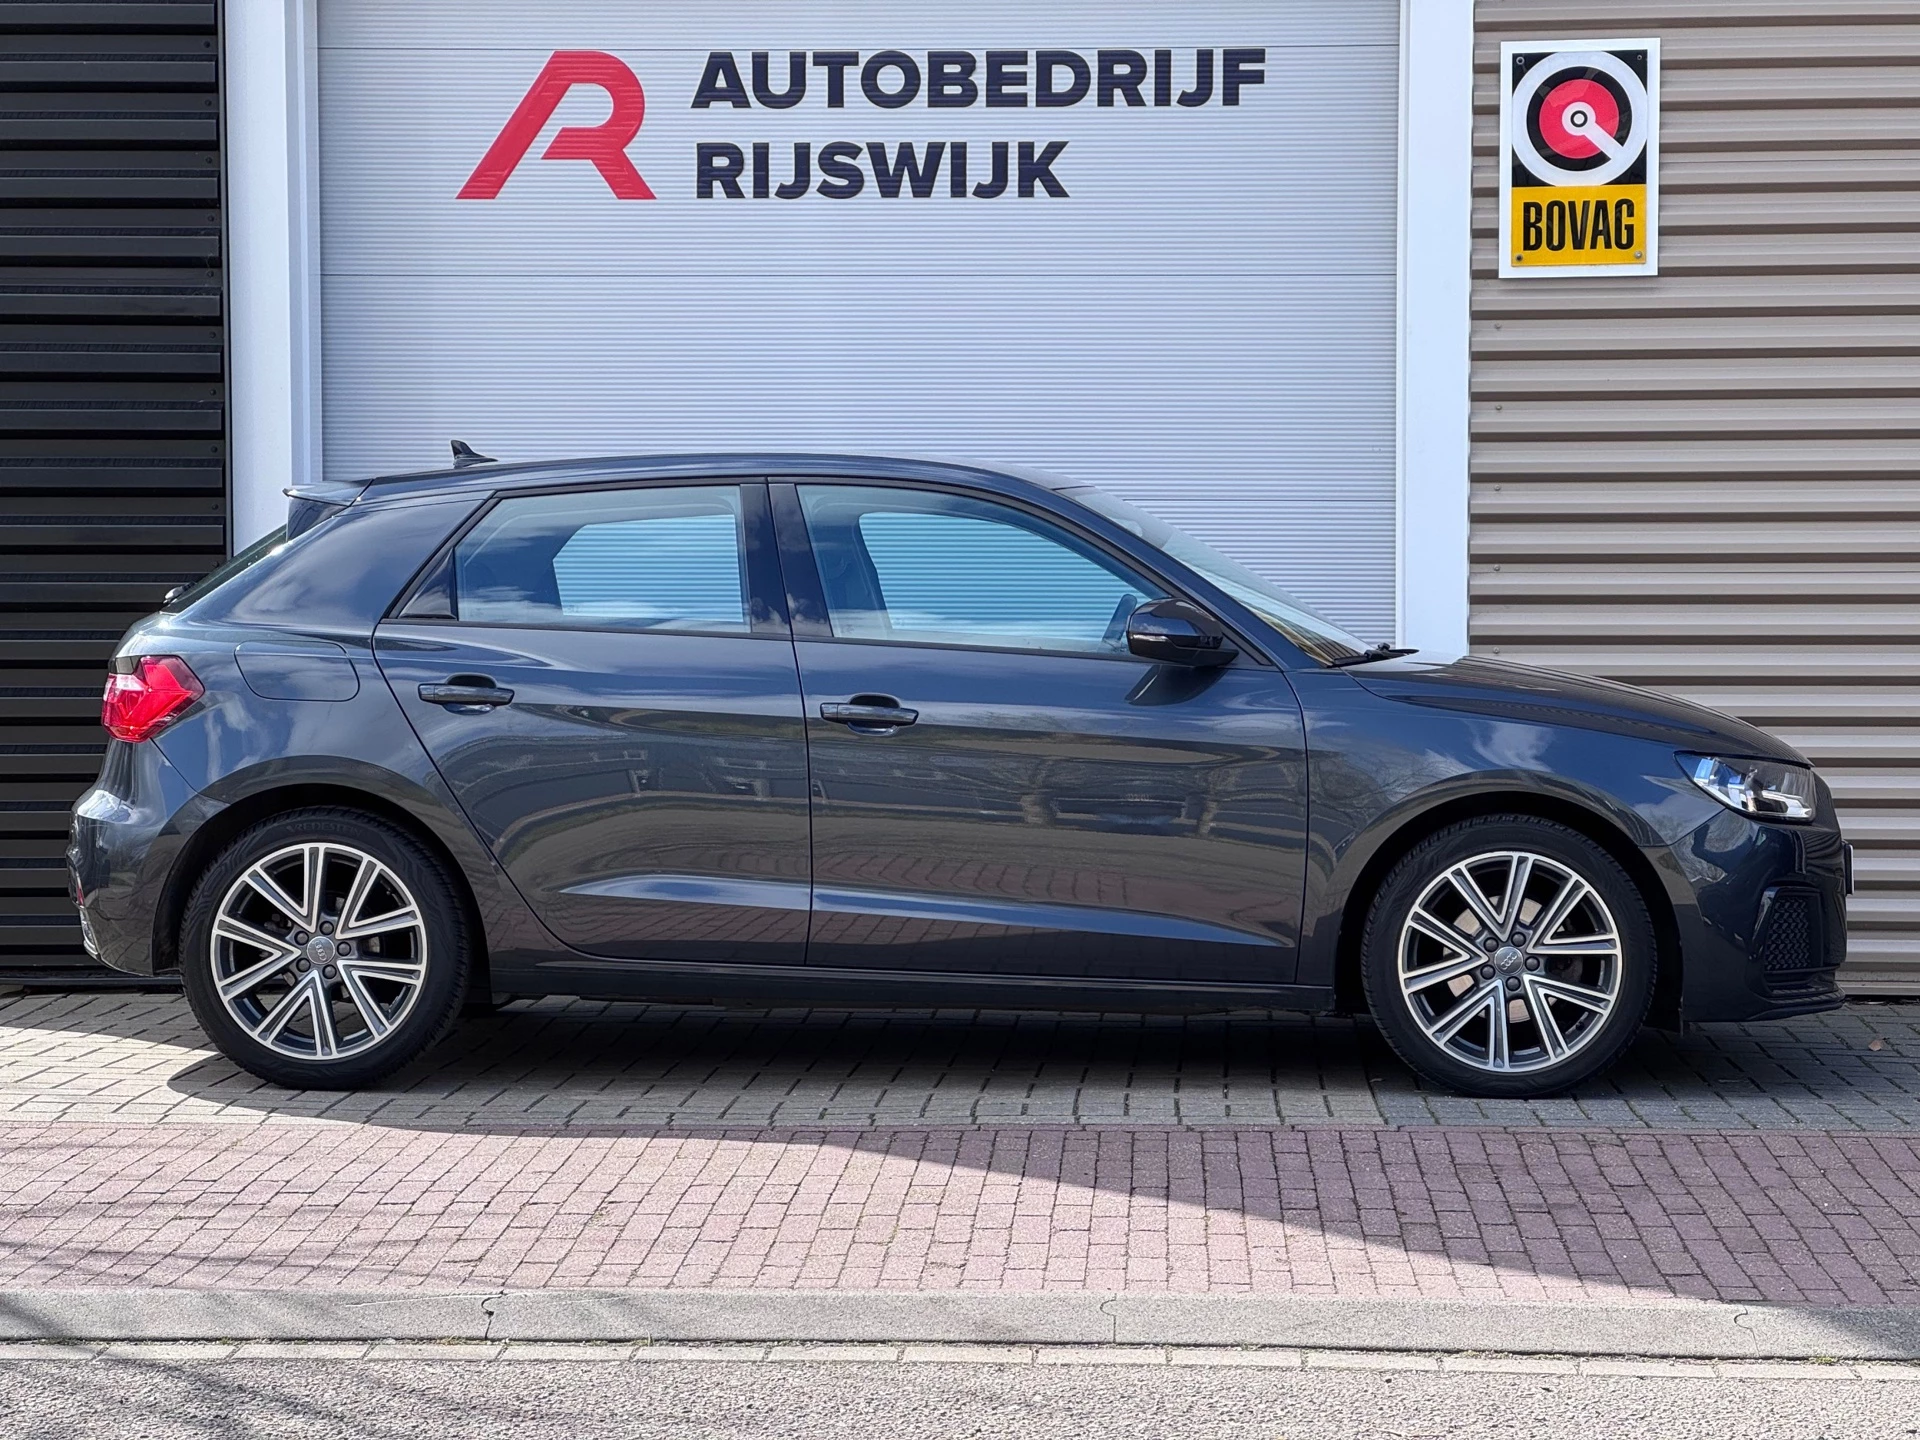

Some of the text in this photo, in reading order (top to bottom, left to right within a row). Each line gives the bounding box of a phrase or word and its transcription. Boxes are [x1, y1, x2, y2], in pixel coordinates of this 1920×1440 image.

[691, 48, 1265, 109] AUTOBEDRIJF
[697, 142, 1069, 200] RIJSWIJK
[1522, 198, 1635, 252] BOVAG
